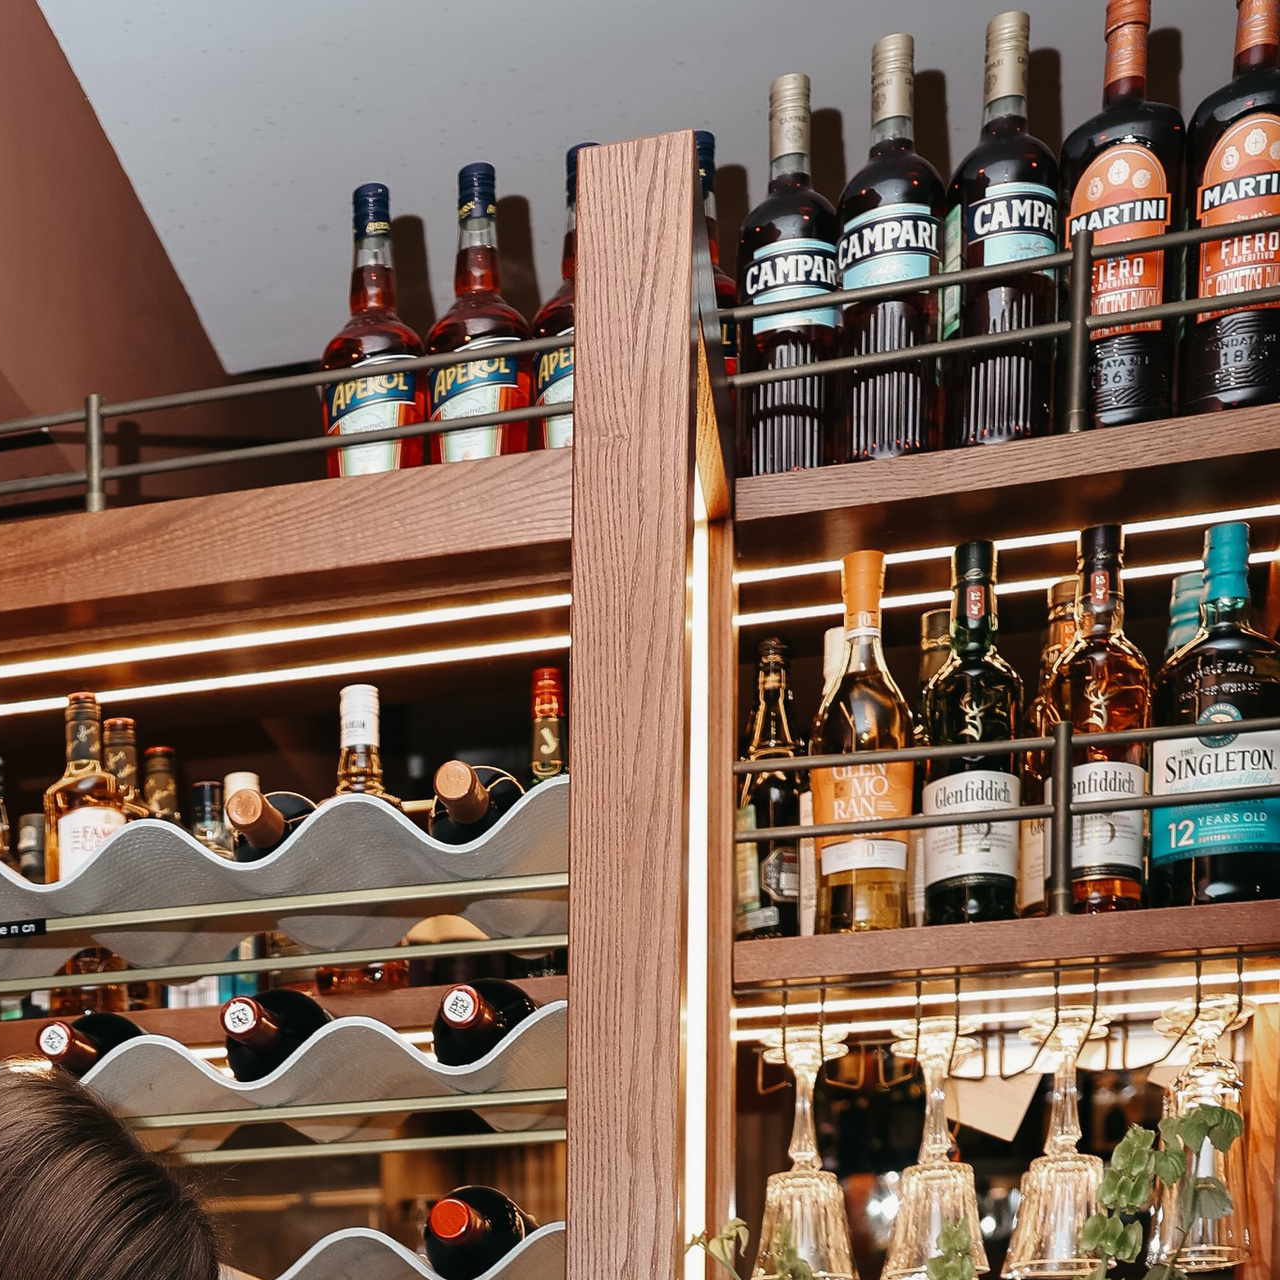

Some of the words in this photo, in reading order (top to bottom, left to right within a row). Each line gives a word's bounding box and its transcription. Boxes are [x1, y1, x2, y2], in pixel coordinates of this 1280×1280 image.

[1202, 173, 1280, 211] MARTI
[973, 199, 1056, 236] CAMPA
[1071, 200, 1166, 236] MARTINI
[837, 219, 938, 271] CAMPARI
[1220, 231, 1279, 260] FIERO
[745, 253, 837, 296] CAMPAR
[1092, 257, 1145, 284] IERO
[331, 375, 409, 417] APEROL
[434, 358, 510, 404] APEROL
[851, 775, 889, 798] MO
[935, 779, 1012, 810] Glenfiddich
[1072, 769, 1135, 796] enfiddich
[834, 796, 877, 820] RAN
[1197, 812, 1240, 826] YEARS
[1242, 811, 1268, 823] OLD
[1168, 818, 1196, 849] 12
